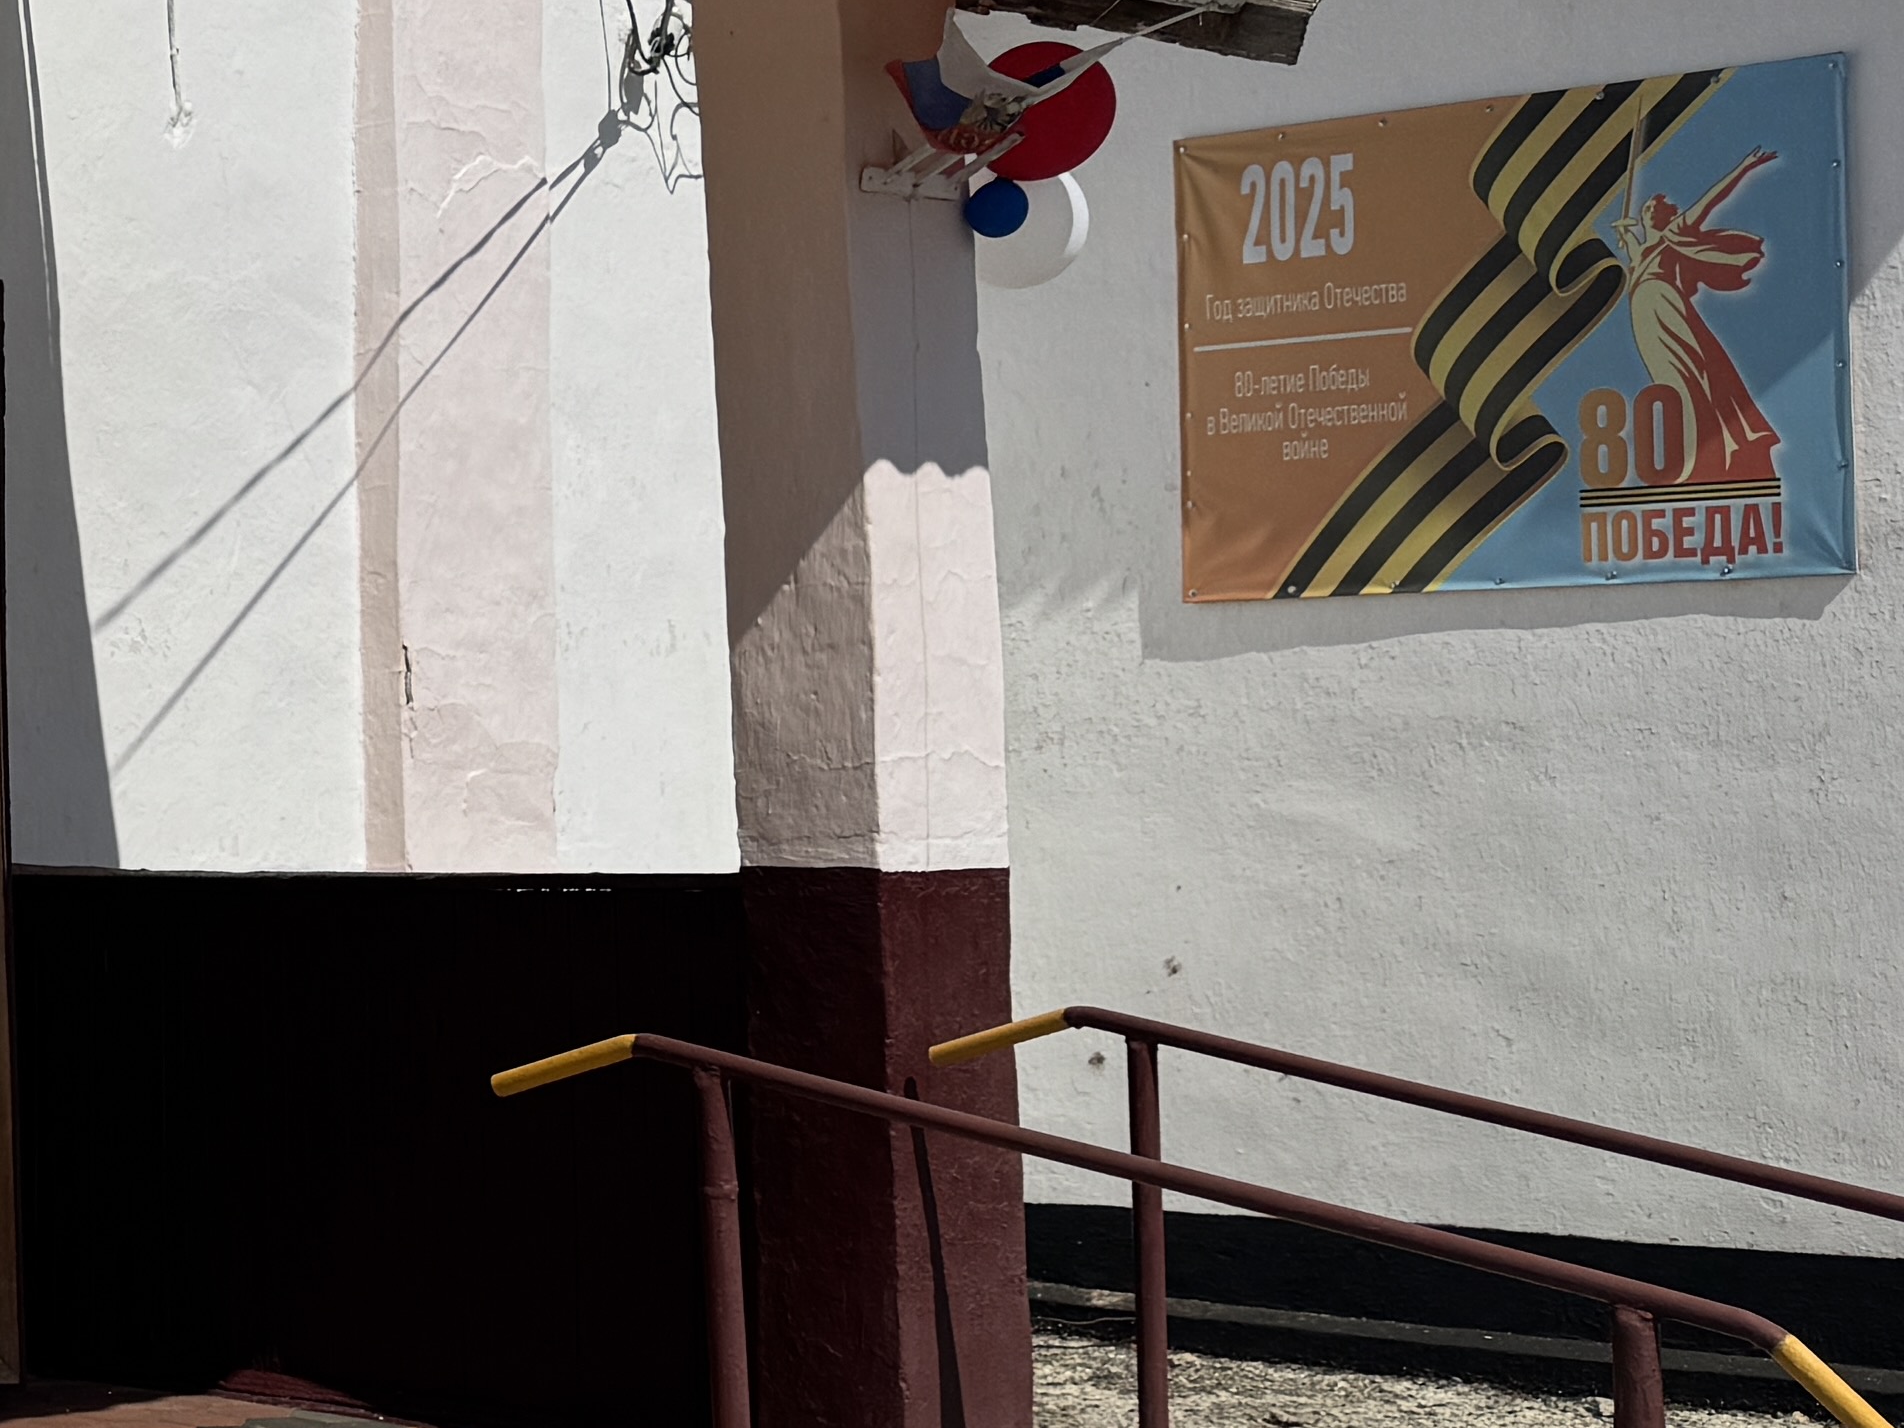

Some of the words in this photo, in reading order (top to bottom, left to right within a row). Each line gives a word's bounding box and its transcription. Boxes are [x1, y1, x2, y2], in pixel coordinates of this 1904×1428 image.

[1241, 153, 1356, 265] 2025
[1206, 294, 1233, 322] Год
[1237, 289, 1320, 318] защитника
[1323, 282, 1407, 310] Отечества
[1234, 371, 1305, 397] 80-летие
[1308, 364, 1370, 392] Победы
[1207, 417, 1215, 435] в
[1219, 402, 1284, 434] Великой
[1288, 392, 1408, 429] Отечественной
[1282, 431, 1329, 461] войне
[1578, 383, 1686, 488] 80
[1580, 502, 1784, 566] ПОБЕДА!
